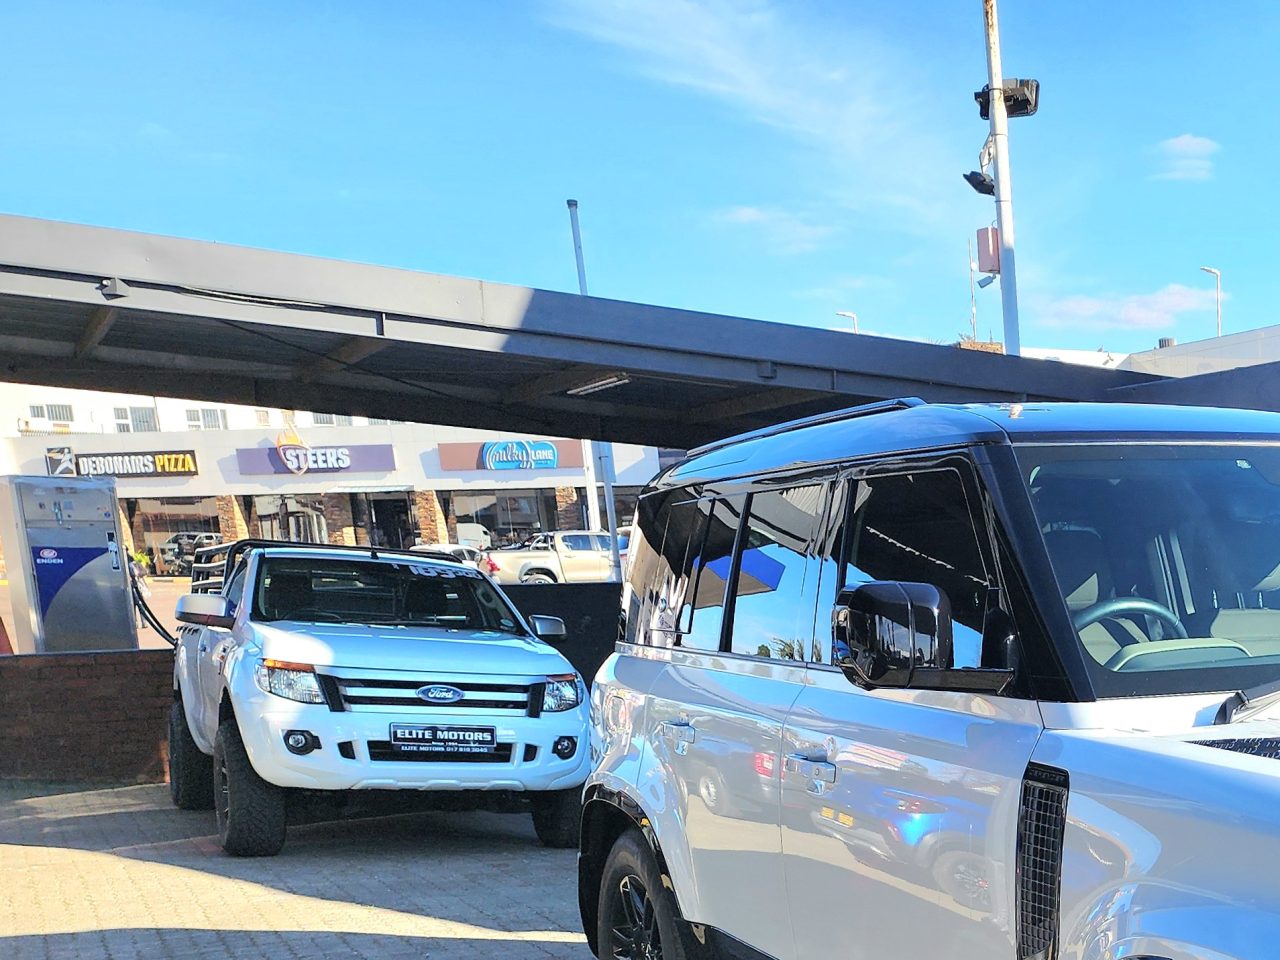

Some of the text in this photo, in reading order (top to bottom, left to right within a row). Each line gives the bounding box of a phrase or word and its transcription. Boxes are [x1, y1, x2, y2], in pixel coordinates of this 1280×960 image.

[285, 447, 350, 469] STEERS
[531, 449, 553, 460] LANE
[78, 453, 196, 475] DEBONAIRS PIZZA
[427, 688, 454, 699] Ford
[396, 729, 492, 741] ELITE MOTORS
